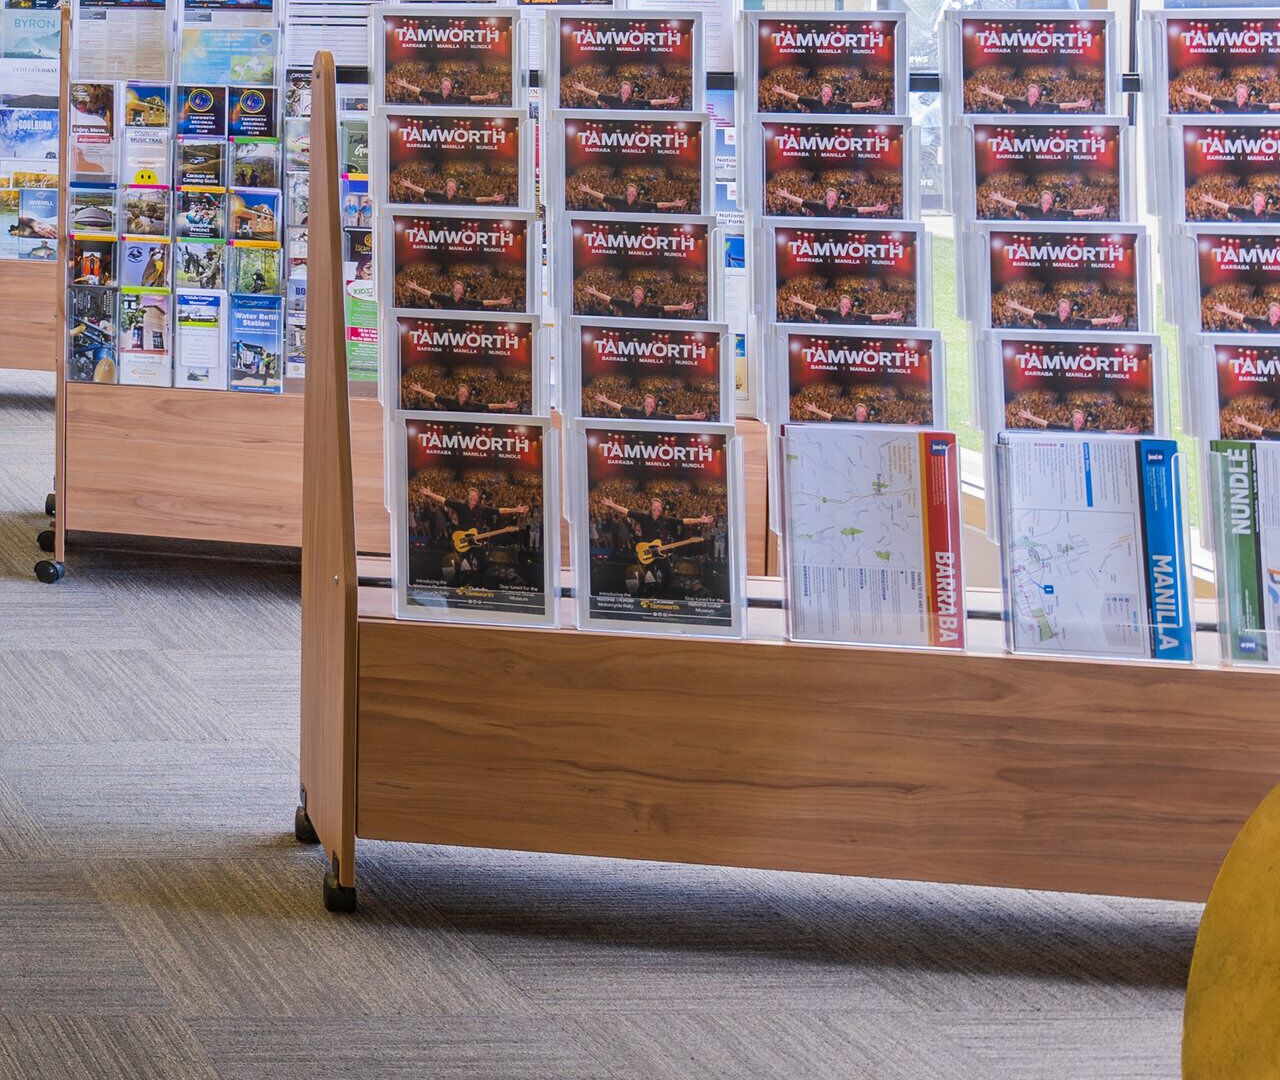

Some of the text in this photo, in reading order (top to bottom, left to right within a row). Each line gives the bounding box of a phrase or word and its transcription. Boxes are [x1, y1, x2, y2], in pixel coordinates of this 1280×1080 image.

[14, 18, 56, 29] BYRON
[396, 27, 500, 43] TAMWORTH
[574, 29, 681, 46] TAMWORTH
[772, 32, 883, 48] TAMWORTH
[976, 32, 1091, 48] TAMWORTH
[1183, 32, 1280, 47] TAMWORT
[18, 120, 52, 131] GOULBURN
[399, 128, 506, 144] TAMWORTH
[578, 131, 688, 148] TAMWORTH
[776, 136, 889, 152] TAMWORTH
[989, 137, 1106, 153] TAMWORTH
[405, 229, 513, 246] TAMWORTH
[584, 233, 695, 251] TAMWORTH
[790, 241, 903, 258] TAMWORTH
[1005, 245, 1124, 262] TAMWORTH
[234, 312, 279, 321] Water Refill
[242, 319, 270, 327] Station
[410, 330, 519, 349] TAMWORTH
[595, 339, 706, 359] TAMWORTH
[803, 348, 919, 367] TAMWORTH
[1016, 354, 1138, 372] TAMWORTH
[419, 433, 529, 453] TAMWORTH
[599, 443, 712, 462] TAMWORTH
[1228, 448, 1251, 535] NUNDLE
[934, 551, 959, 642] BARRABA
[1152, 555, 1179, 650] MANILLA
